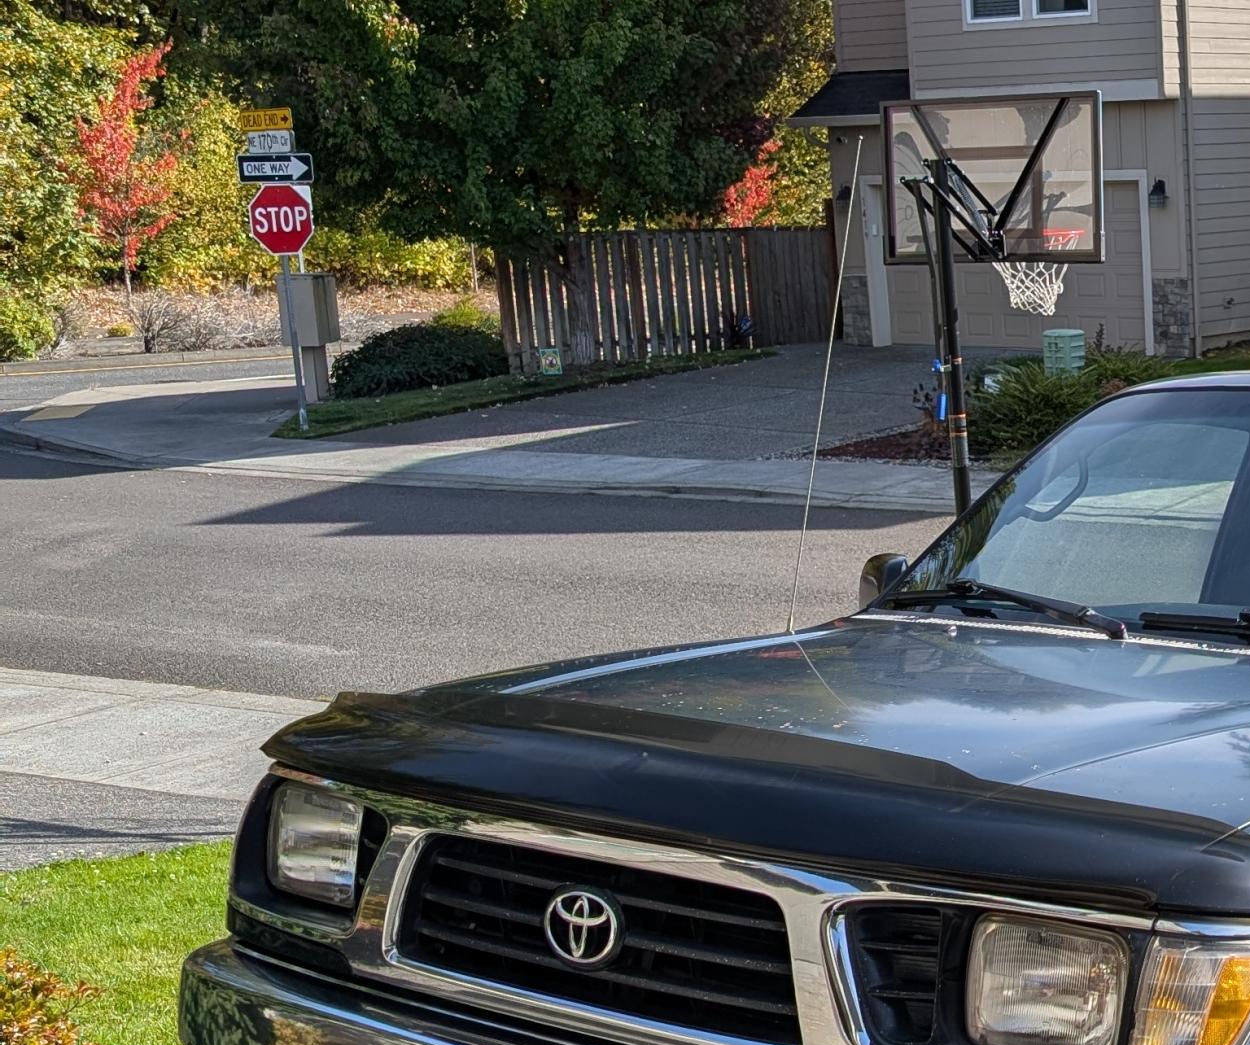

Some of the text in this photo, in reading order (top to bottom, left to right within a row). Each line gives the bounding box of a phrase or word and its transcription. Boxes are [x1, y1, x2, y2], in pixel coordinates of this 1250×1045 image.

[243, 114, 279, 128] DEAD END
[258, 133, 279, 151] 170th
[246, 163, 290, 174] ONE WAY
[254, 206, 308, 234] STOP
